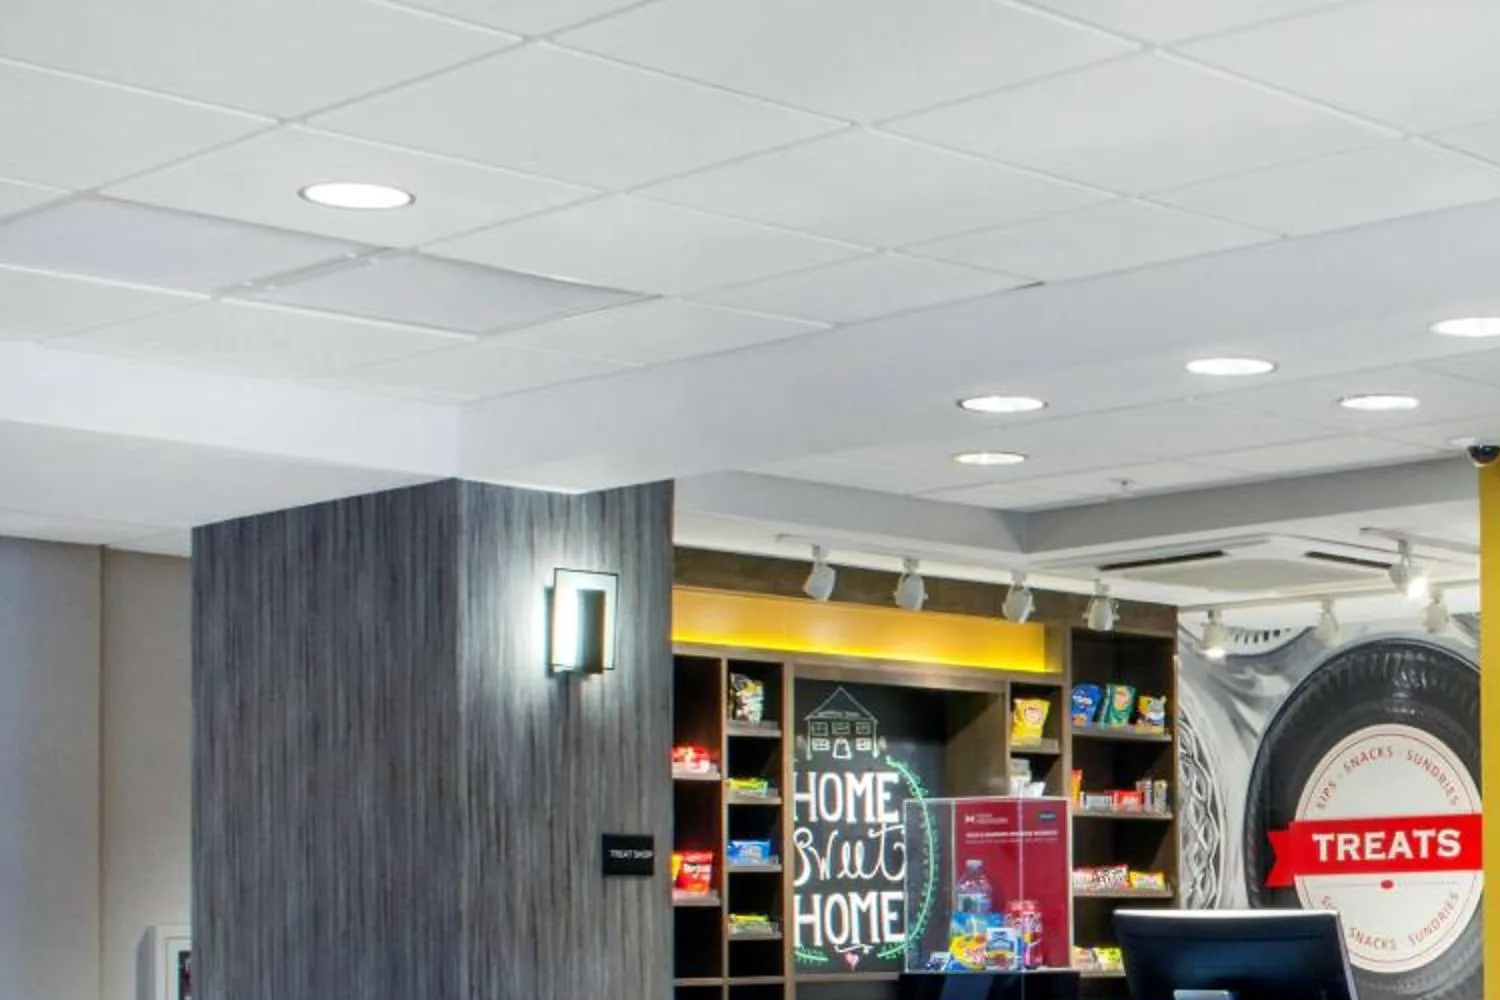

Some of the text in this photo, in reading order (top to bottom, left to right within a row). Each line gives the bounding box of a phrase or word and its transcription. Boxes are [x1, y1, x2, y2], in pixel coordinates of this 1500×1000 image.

[793, 771, 900, 823] HOME
[1343, 745, 1394, 774] SNACKS
[1406, 749, 1460, 807] SUNDRIES
[1311, 828, 1462, 863] TREATS
[793, 890, 906, 947] HOME
[1350, 891, 1460, 951] SNACKS SUNDRIES
